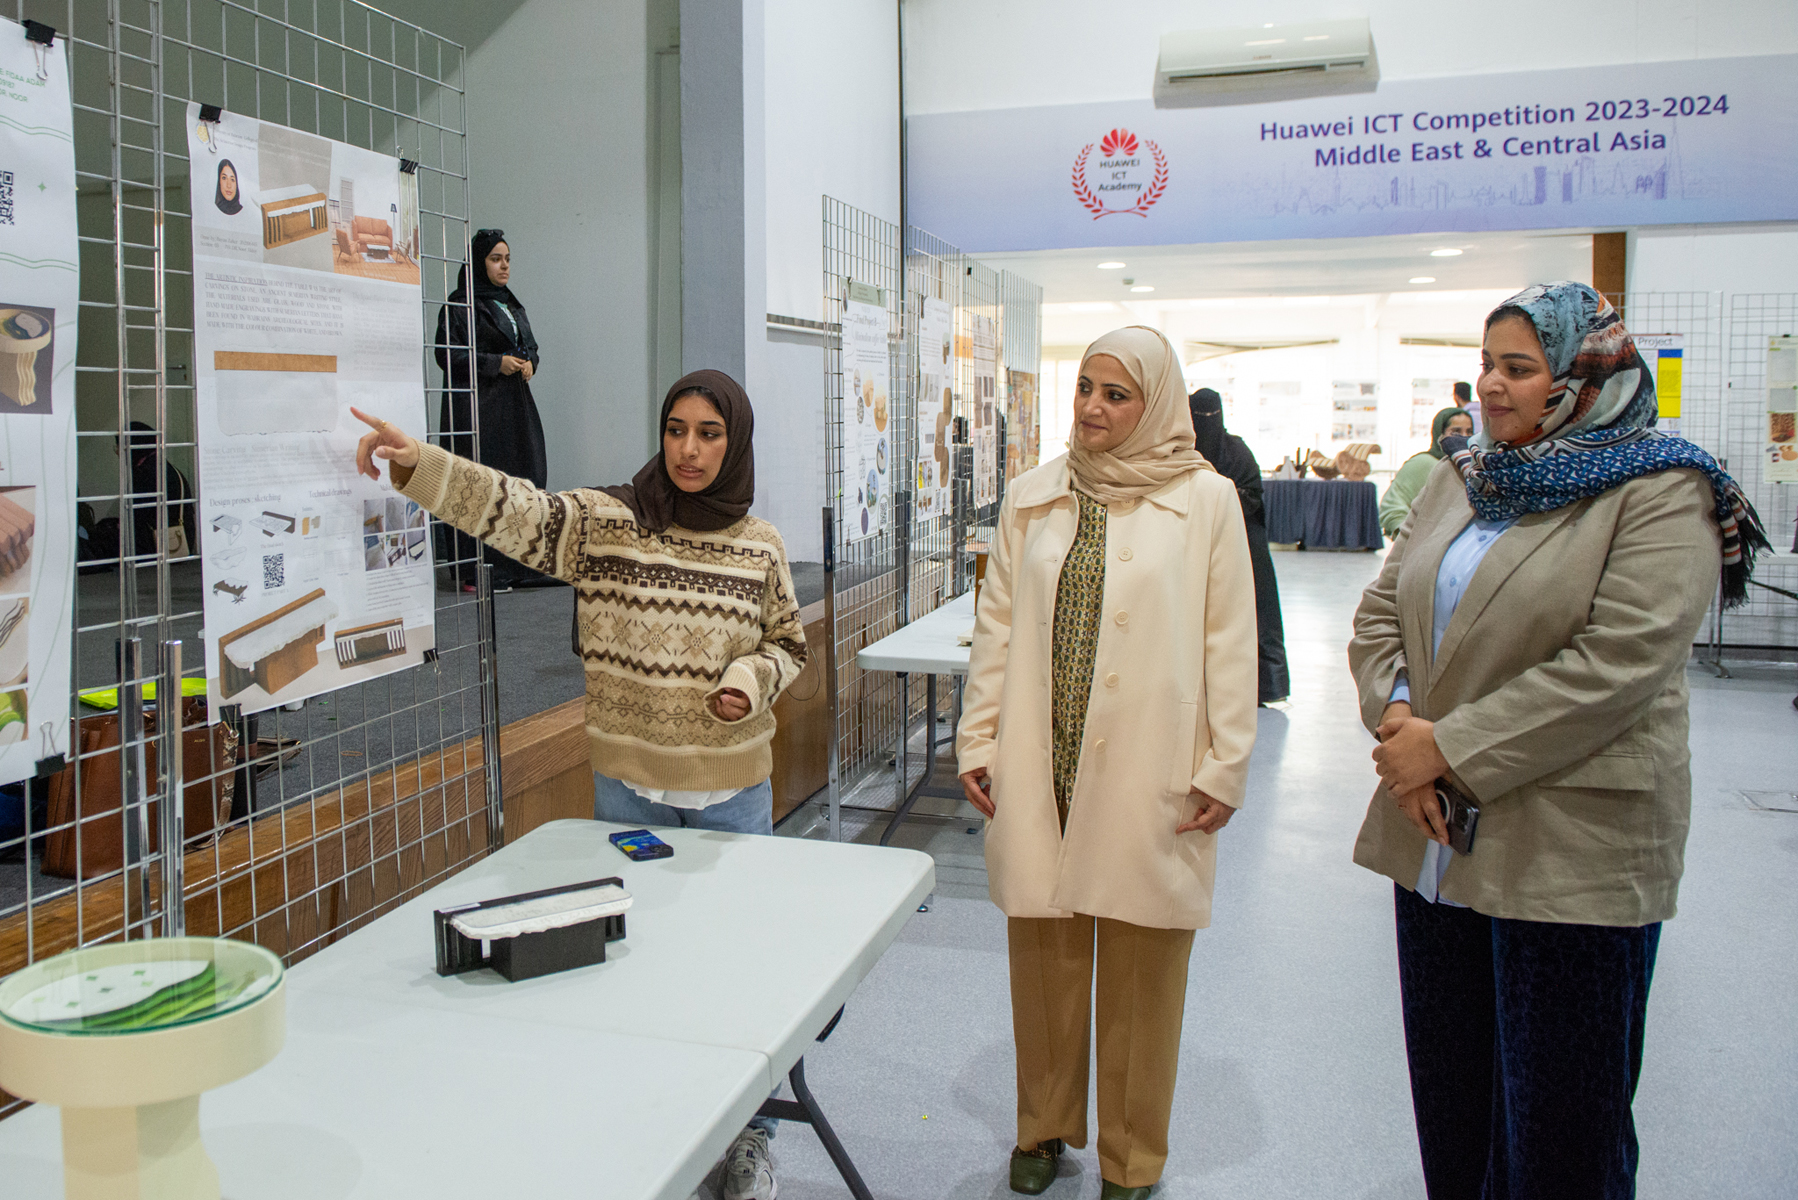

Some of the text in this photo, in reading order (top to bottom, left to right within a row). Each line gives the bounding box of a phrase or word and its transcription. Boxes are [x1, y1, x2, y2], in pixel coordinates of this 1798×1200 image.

[8, 91, 28, 103] NOOR
[1260, 93, 1730, 141] Huawei ICT Competition 2023-2024
[1314, 128, 1667, 168] Middle East & Central Asia
[1099, 158, 1141, 169] HUAWEI
[1111, 171, 1127, 180] ICT
[1097, 181, 1142, 192] Academy
[1638, 337, 1673, 348] Project
[308, 488, 331, 498] Technical
[209, 498, 231, 508] Design
[231, 498, 251, 507] proses
[254, 493, 281, 503] sketching
